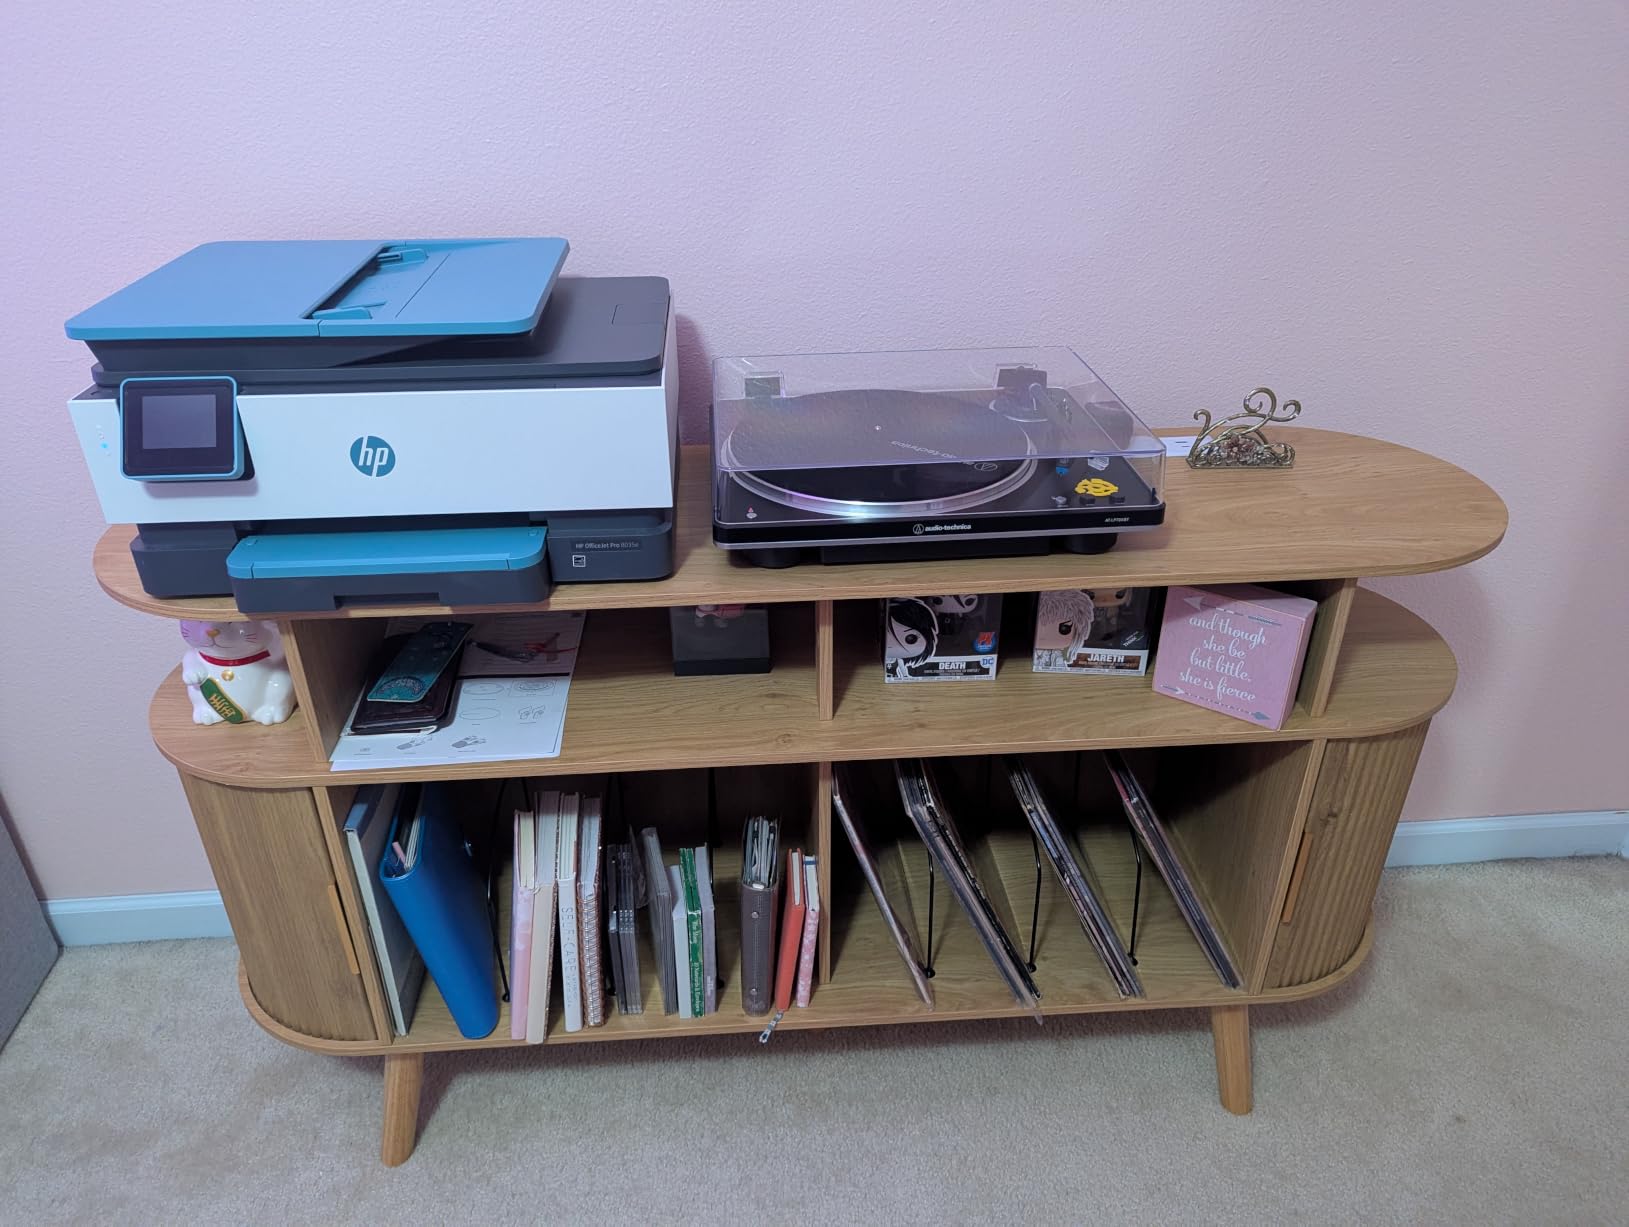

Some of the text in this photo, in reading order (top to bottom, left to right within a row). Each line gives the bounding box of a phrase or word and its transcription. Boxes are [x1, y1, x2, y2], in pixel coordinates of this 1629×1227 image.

[358, 435, 389, 478] hp
[925, 523, 971, 532] audio-technica
[1189, 613, 1266, 649] and though
[1087, 653, 1125, 663] JARETH
[1190, 647, 1213, 669] but
[1202, 635, 1245, 659] she be
[938, 661, 966, 670] DEATH
[982, 658, 994, 666] DC
[1179, 667, 1257, 700] she is fierce
